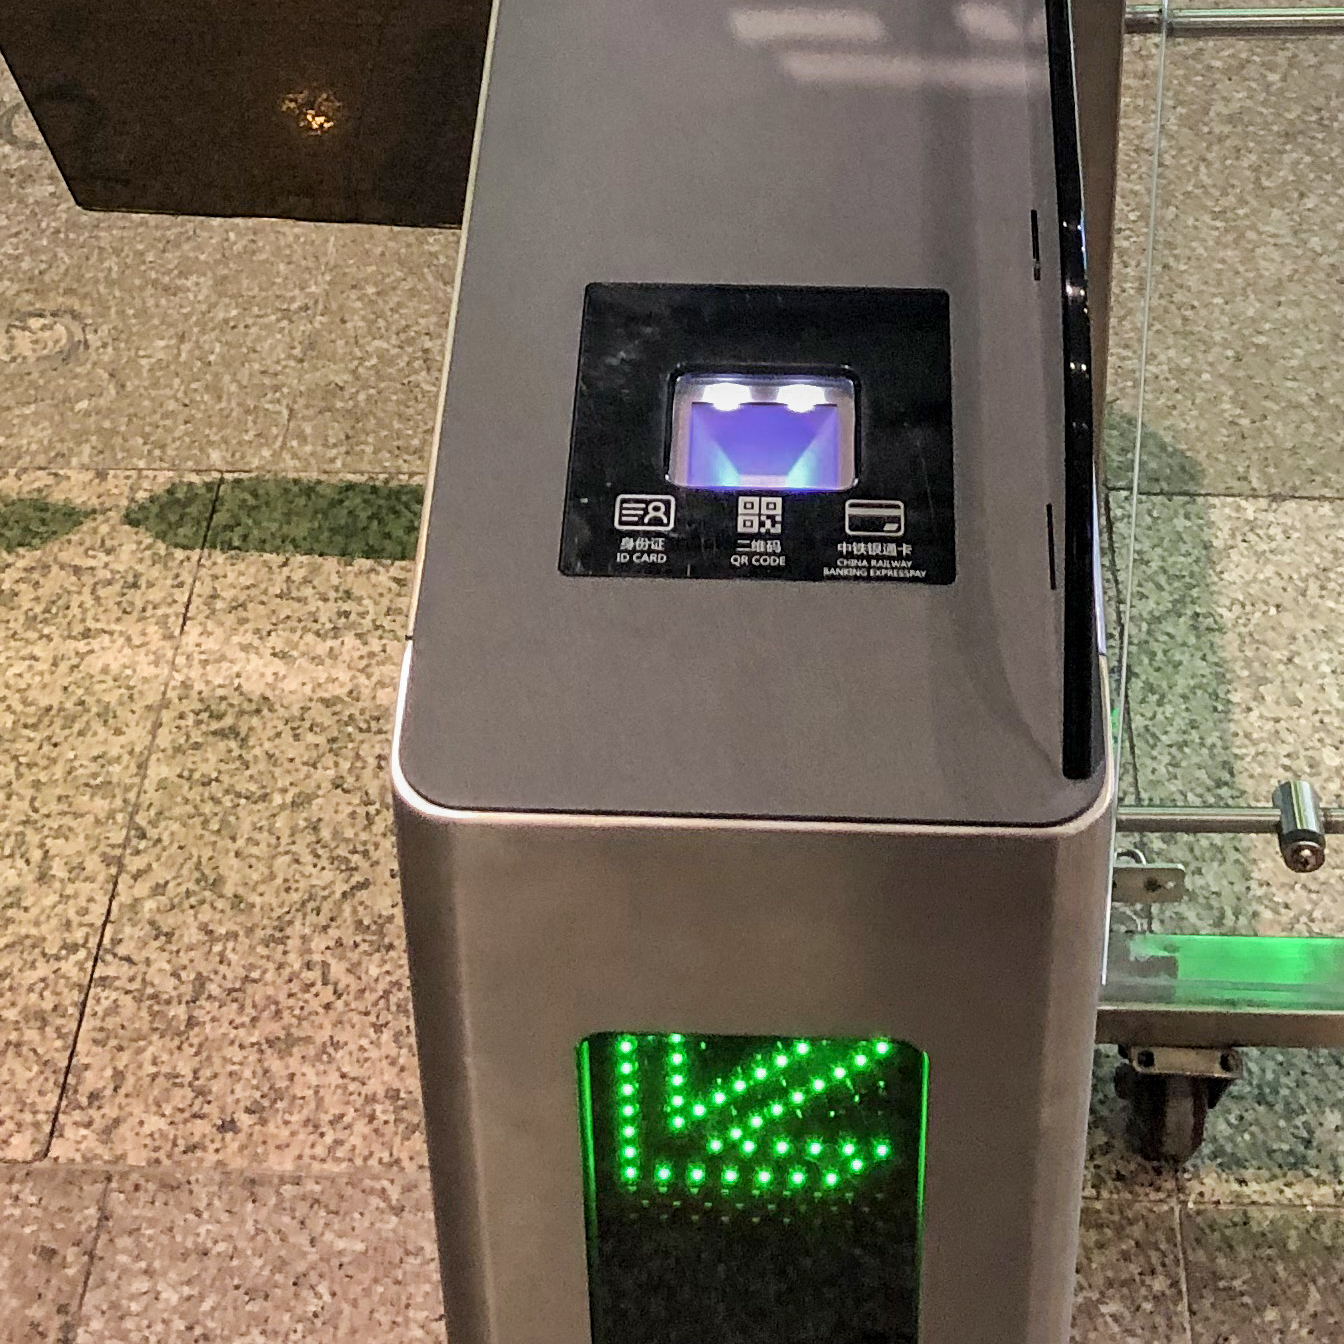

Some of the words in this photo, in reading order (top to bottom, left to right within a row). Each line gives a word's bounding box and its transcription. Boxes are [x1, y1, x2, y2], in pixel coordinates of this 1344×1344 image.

[619, 537, 666, 551] 身份证
[735, 539, 782, 553] 二维码
[837, 541, 913, 557] 中铁银通卡
[616, 552, 630, 564] ID
[632, 552, 668, 564] CARD
[730, 555, 749, 567] QR
[751, 555, 786, 567] CODE
[836, 558, 869, 567] CHINA
[870, 559, 913, 568] RAILWAY
[823, 567, 868, 577] BANKING
